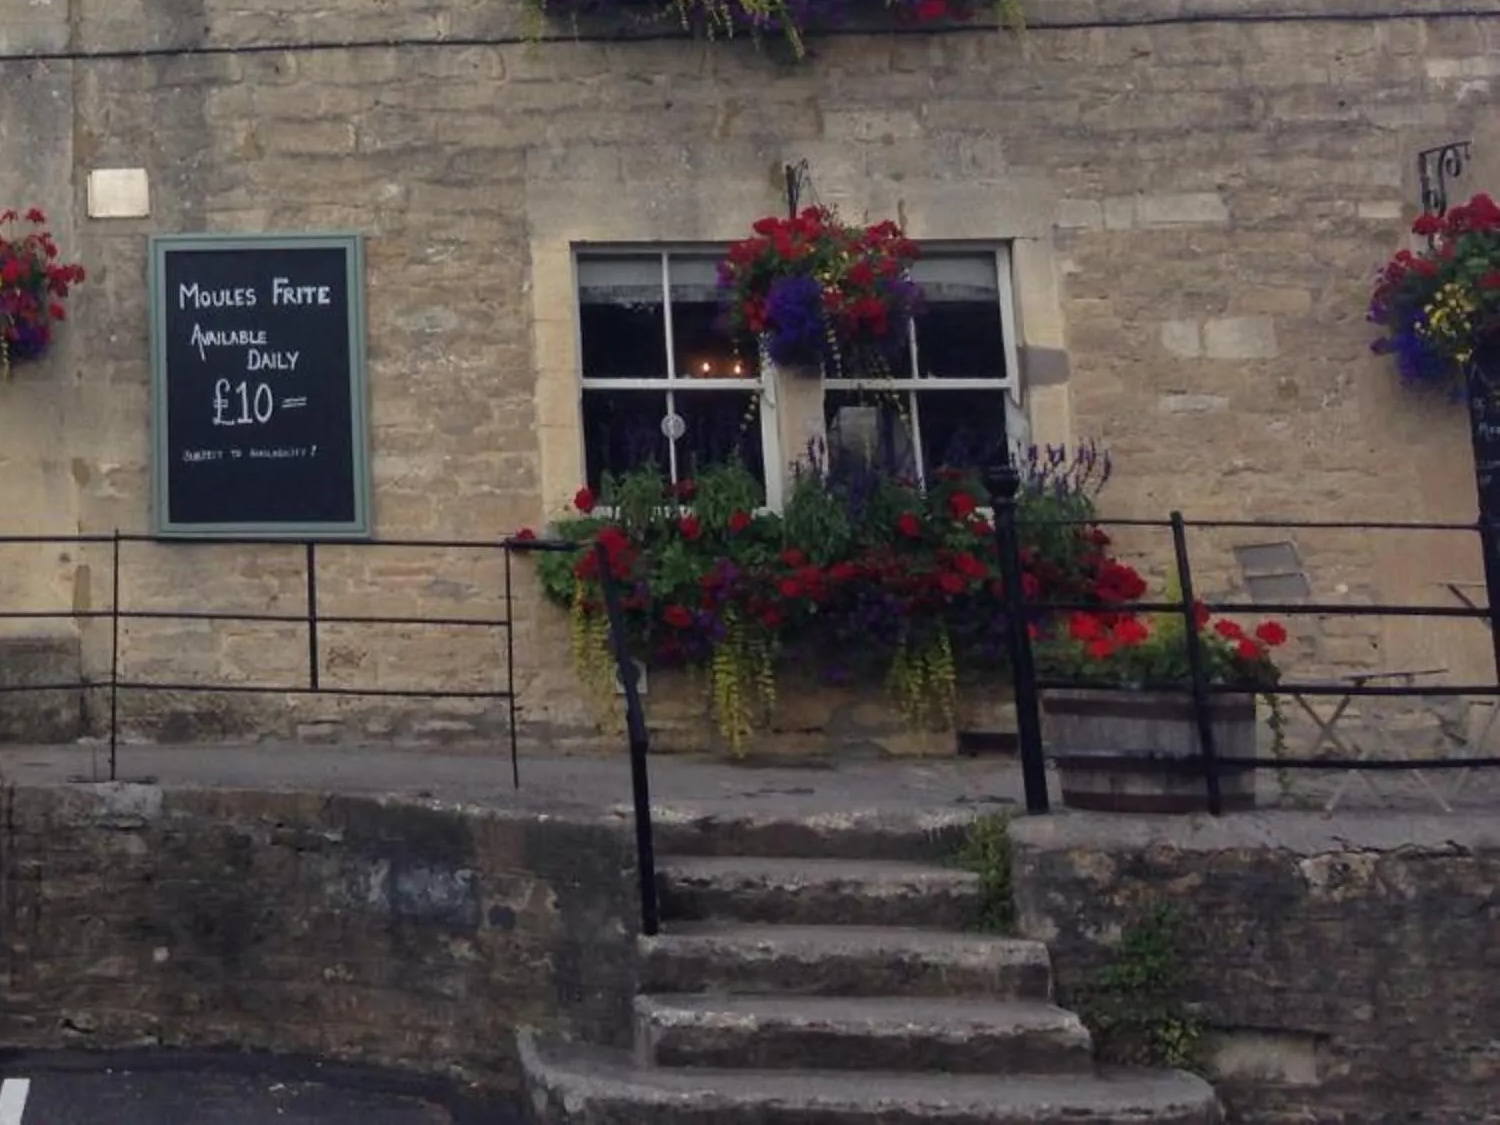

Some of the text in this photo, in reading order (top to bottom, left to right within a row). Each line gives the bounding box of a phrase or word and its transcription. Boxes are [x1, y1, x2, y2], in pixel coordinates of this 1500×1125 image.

[179, 277, 331, 310] MOULES FRITE
[191, 323, 268, 362] AVAILABLE
[247, 349, 300, 371] DAILY
